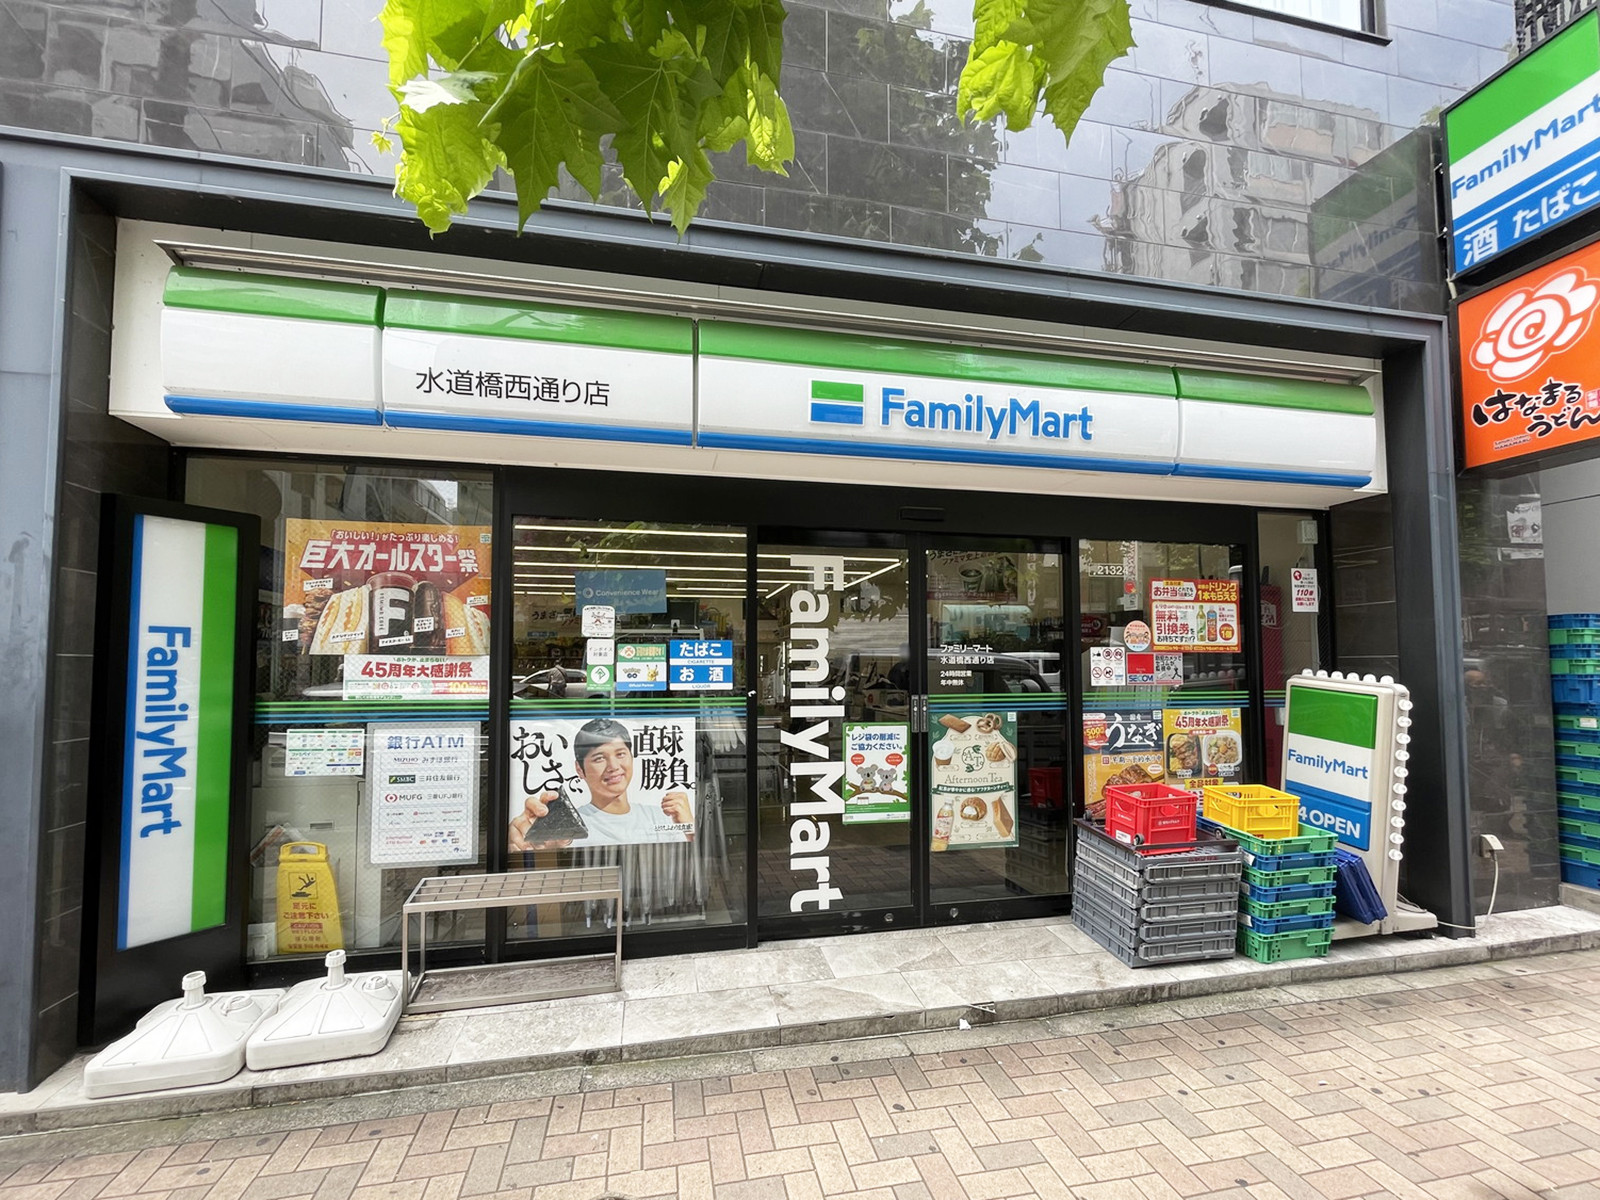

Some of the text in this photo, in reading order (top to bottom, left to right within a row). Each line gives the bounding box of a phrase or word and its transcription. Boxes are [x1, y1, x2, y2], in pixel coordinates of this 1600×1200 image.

[1452, 93, 1600, 199] FamilyMart
[1463, 170, 1600, 266] 酒 たばこ
[416, 367, 610, 407] 水道橋西通り店
[882, 387, 1093, 440] FamilyMart
[1472, 378, 1582, 427] はなまる
[1526, 406, 1600, 437] うどん
[300, 540, 479, 573] 巨大オールスター祭
[641, 588, 659, 596] Wear
[1153, 586, 1178, 597] お弁当
[1197, 590, 1238, 601] 1本もらえる
[1155, 610, 1179, 622] 無料
[679, 642, 723, 657] たばこ
[940, 644, 994, 653] ファミリーマート
[361, 660, 473, 679] 45周年大感謝祭
[1128, 674, 1154, 682] SECOM
[136, 625, 191, 839] FamilyMart
[780, 553, 846, 913] FamilyMart
[1105, 712, 1162, 751] うなぎ
[1175, 714, 1229, 728] 45周年大感謝祭
[387, 735, 464, 750] 銀行ATM
[510, 726, 568, 760] おい
[633, 725, 684, 758] 直球
[851, 732, 901, 741] レジ袋の削減に
[851, 743, 903, 751] ご協力ください。
[639, 757, 696, 791] 勝負。
[944, 772, 1003, 784] Afternoon Tea
[1288, 748, 1369, 780] FamilyMart
[1309, 809, 1361, 839] OPEN
